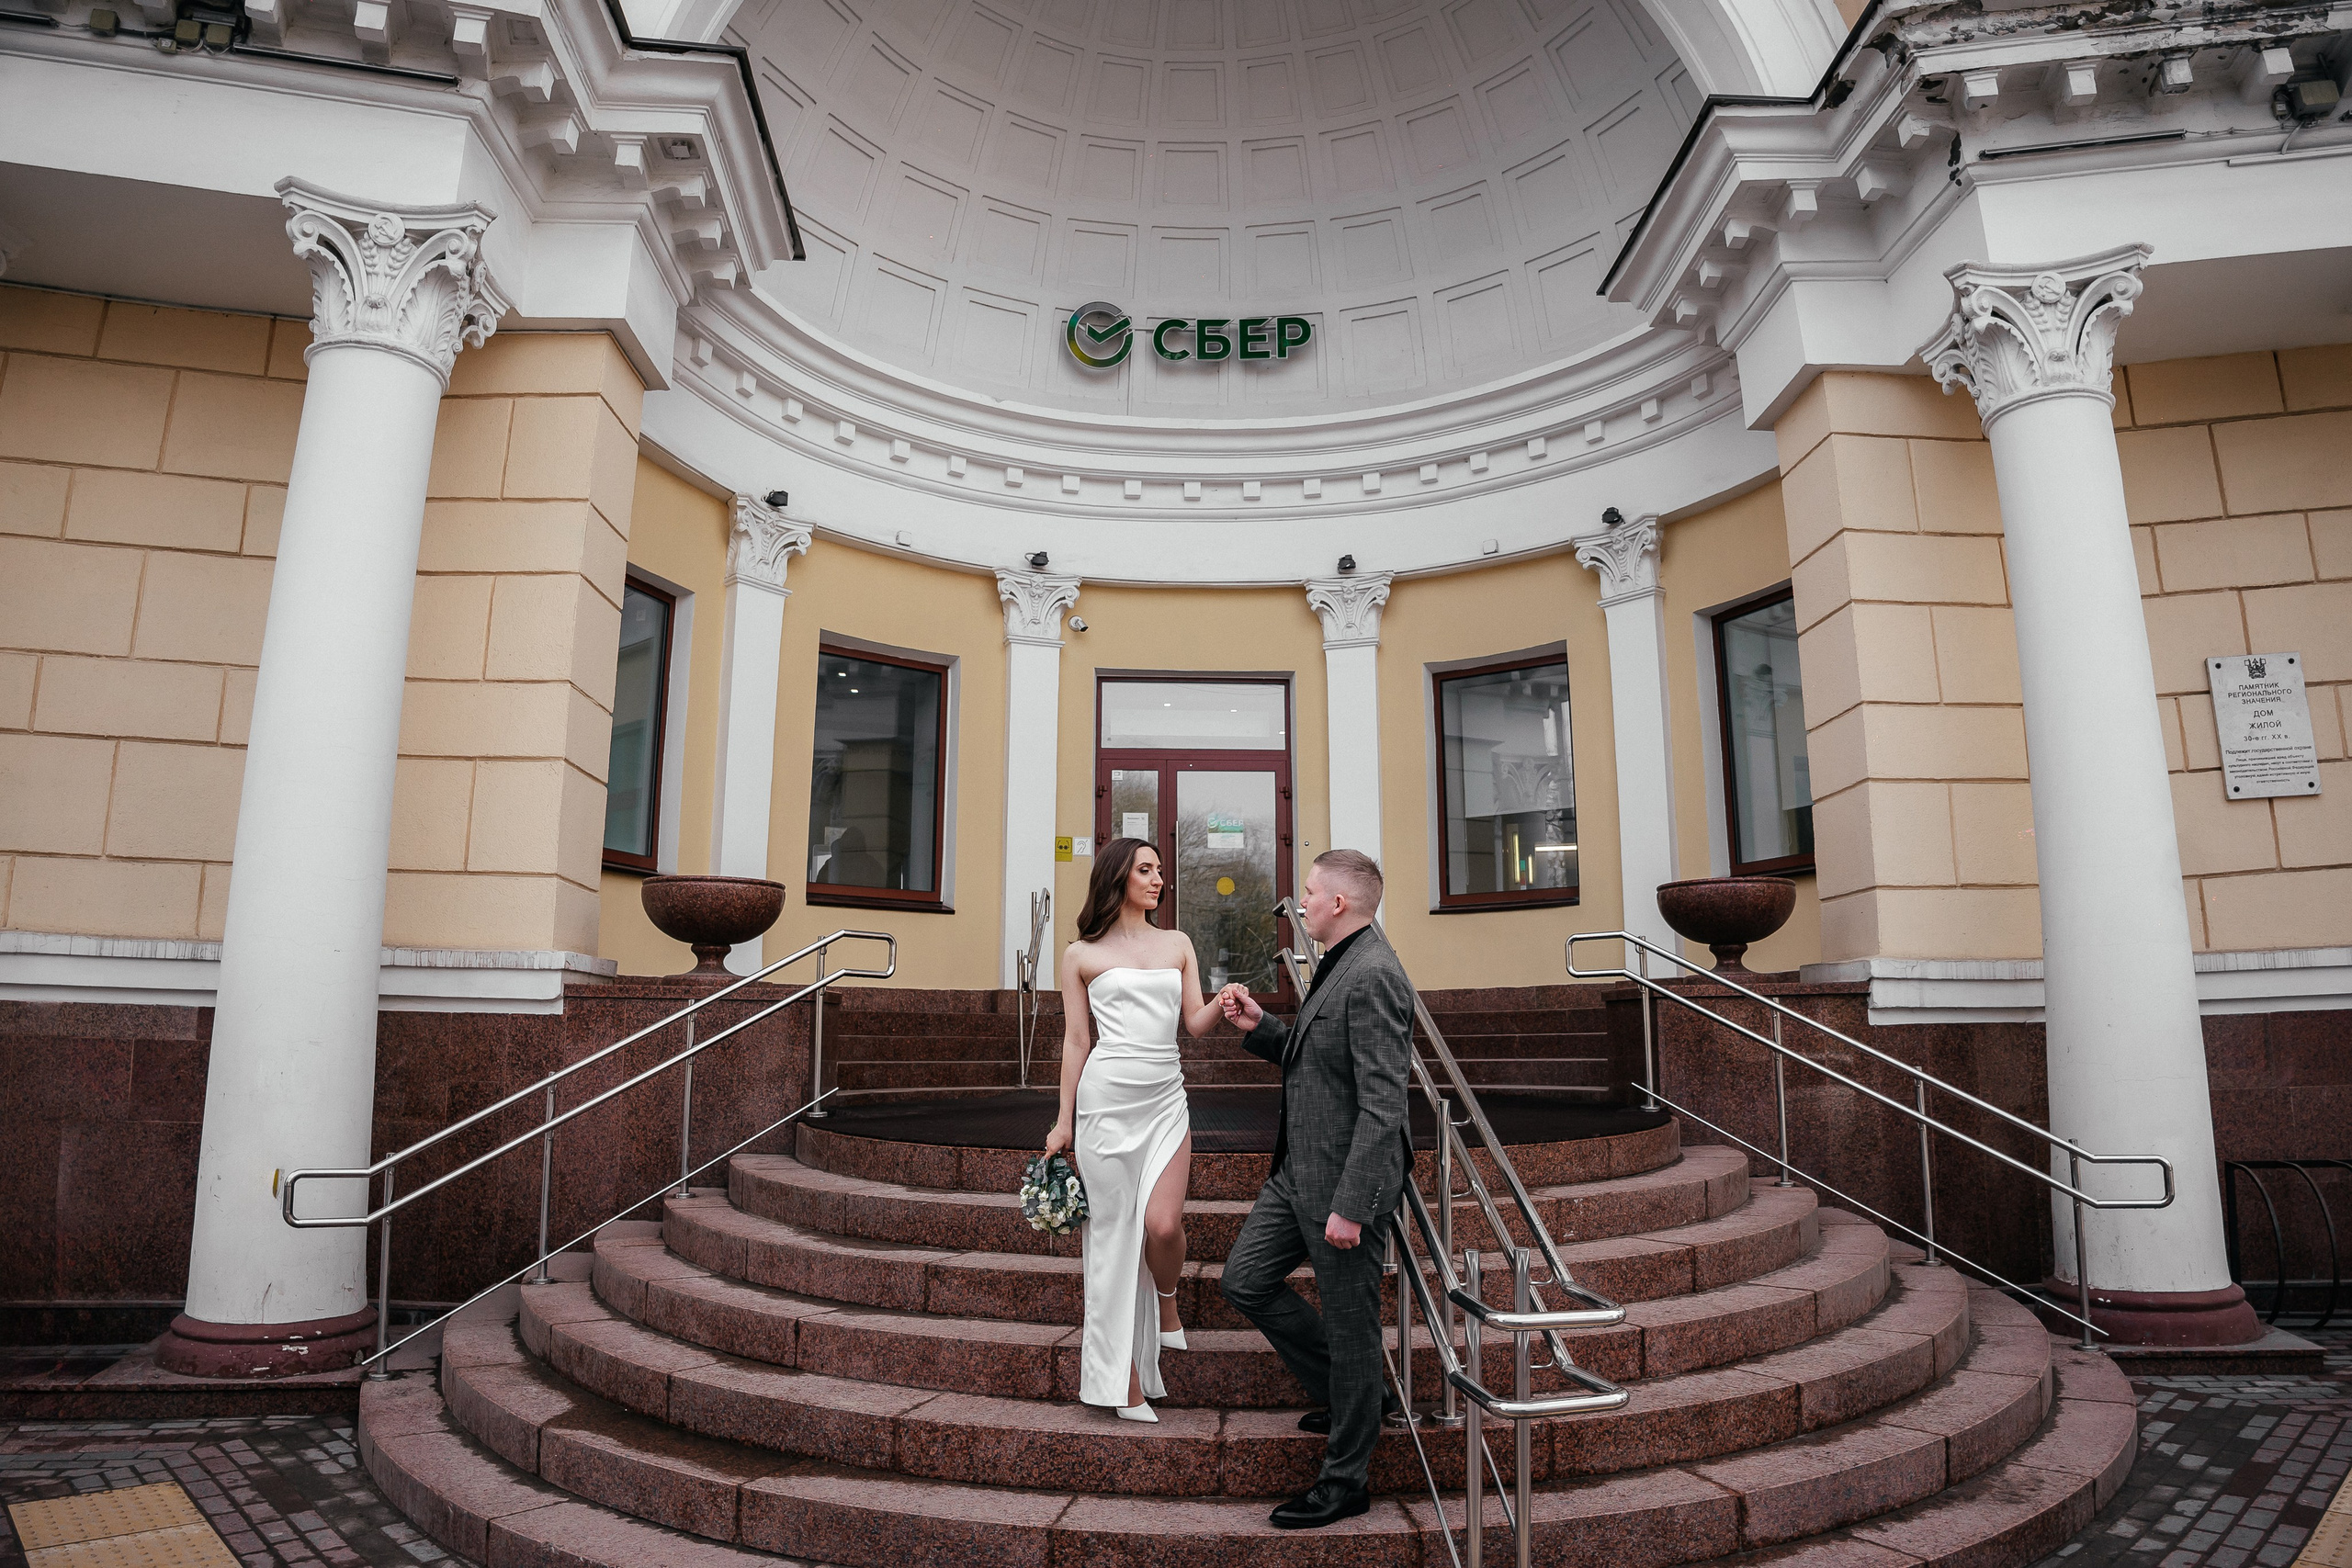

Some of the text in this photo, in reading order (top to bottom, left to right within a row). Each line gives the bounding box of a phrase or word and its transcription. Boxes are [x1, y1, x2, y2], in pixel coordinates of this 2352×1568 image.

[1152, 317, 1312, 361] СБЕР
[2238, 682, 2279, 691] ПАМЯТНИК
[2228, 689, 2292, 698] РЕГИОНАЛЬНОГО
[2242, 696, 2281, 705] ЗНАЧЕНИЯ
[2254, 709, 2274, 718] ДОМ
[2249, 720, 2281, 729] ЖИЛОЙ
